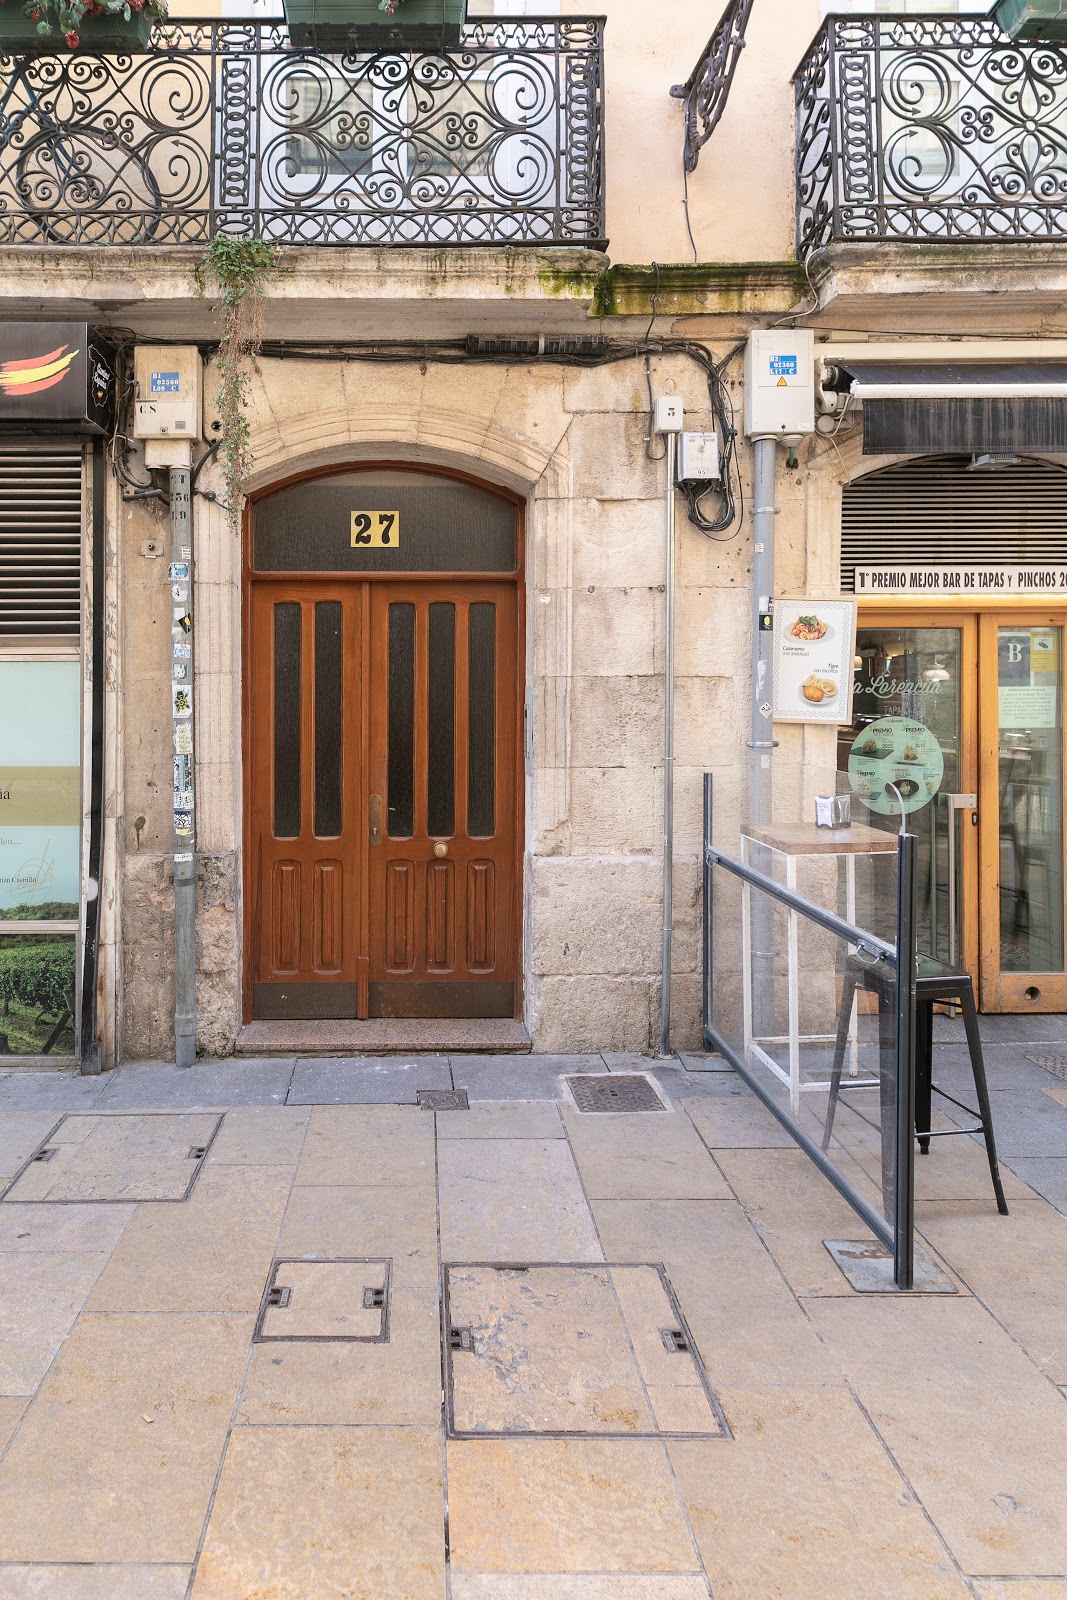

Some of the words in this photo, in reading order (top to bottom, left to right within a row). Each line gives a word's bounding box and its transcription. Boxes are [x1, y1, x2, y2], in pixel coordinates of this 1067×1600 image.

[354, 513, 395, 544] 27
[871, 572, 906, 587] PREMIO
[909, 572, 939, 587] MEJOR
[943, 572, 960, 587] BAR
[964, 572, 975, 587] DE
[978, 572, 1005, 587] TAPAS
[1018, 571, 1056, 587] PINCHOS
[1007, 643, 1022, 662] B
[865, 675, 942, 699] Lorencita
